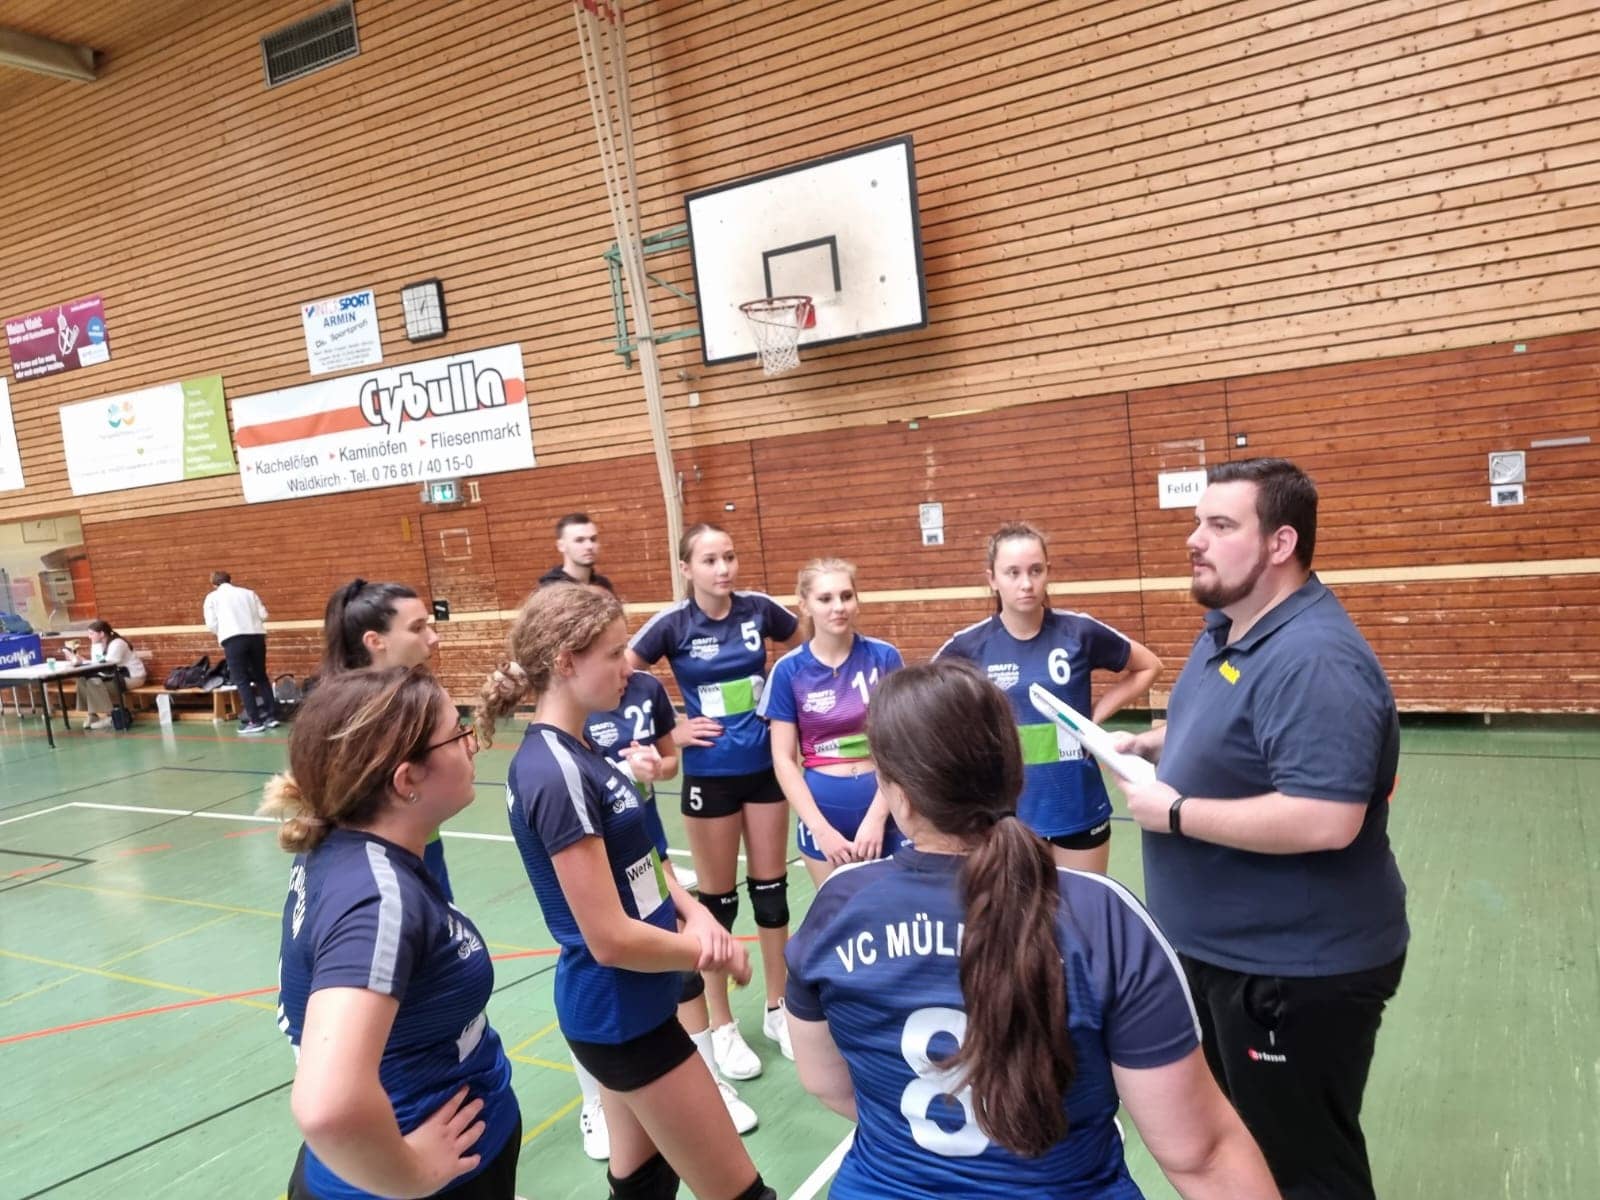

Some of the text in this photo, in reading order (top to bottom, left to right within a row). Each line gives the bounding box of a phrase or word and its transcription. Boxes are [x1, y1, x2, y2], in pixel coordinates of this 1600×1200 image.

[324, 312, 356, 327] ARMIN
[360, 360, 507, 435] Cybulla
[255, 454, 319, 475] Kachelöfen
[339, 440, 407, 462] Kaminöfen
[431, 421, 521, 449] Fliesenmarkt
[287, 473, 341, 492] Waldkirch
[350, 468, 370, 483] Tel.
[1167, 482, 1192, 494] Feld
[741, 621, 761, 651] 5
[1047, 648, 1071, 685] 6
[690, 787, 703, 811] 5
[628, 857, 652, 881] Werk
[836, 930, 877, 973] VC
[900, 1006, 990, 1157] 8
